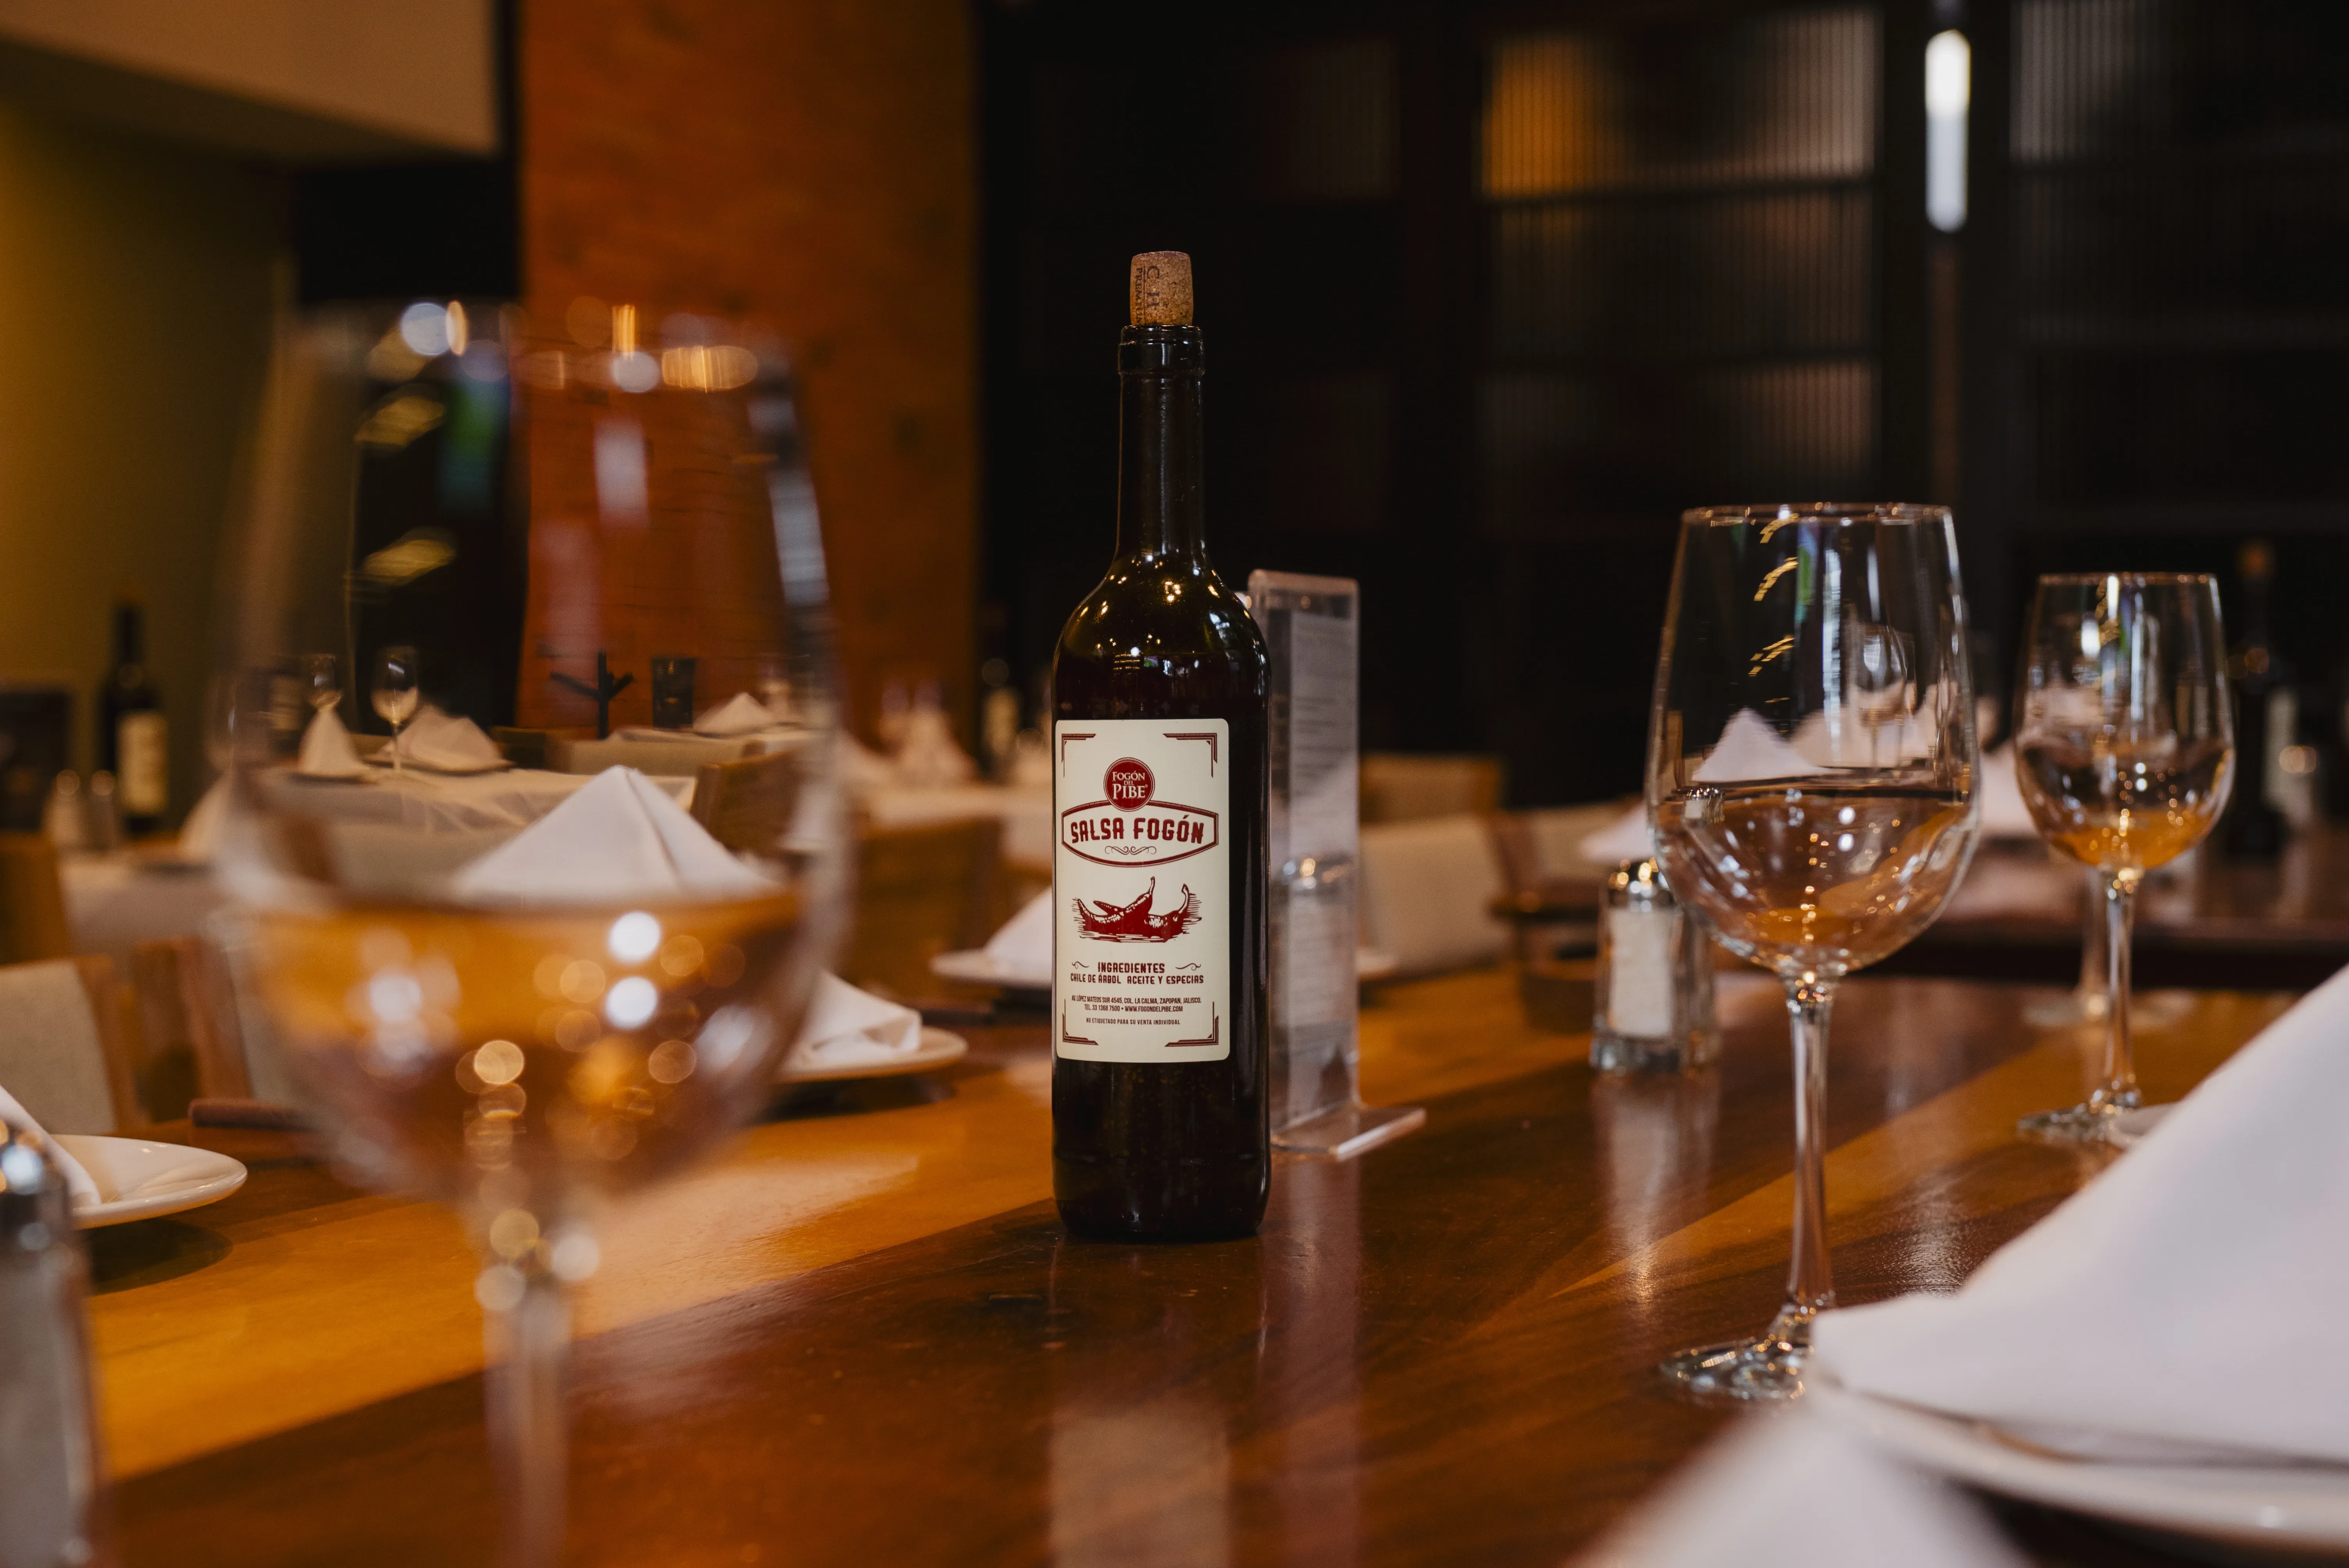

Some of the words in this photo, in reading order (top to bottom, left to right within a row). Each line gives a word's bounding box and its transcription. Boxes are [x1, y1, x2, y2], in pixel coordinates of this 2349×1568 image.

[1112, 771, 1145, 781] FOGÓN
[1071, 818, 1124, 844] SALSA
[1133, 815, 1204, 844] FOGÓN
[1098, 962, 1165, 973] INGREDIENTES
[1071, 973, 1086, 982] CHILE
[1088, 974, 1096, 983] DE
[1098, 973, 1121, 984] ÁRBOL
[1127, 976, 1155, 984] ACEITE
[1158, 976, 1163, 984] Y
[1166, 975, 1204, 984] ESPECIAS
